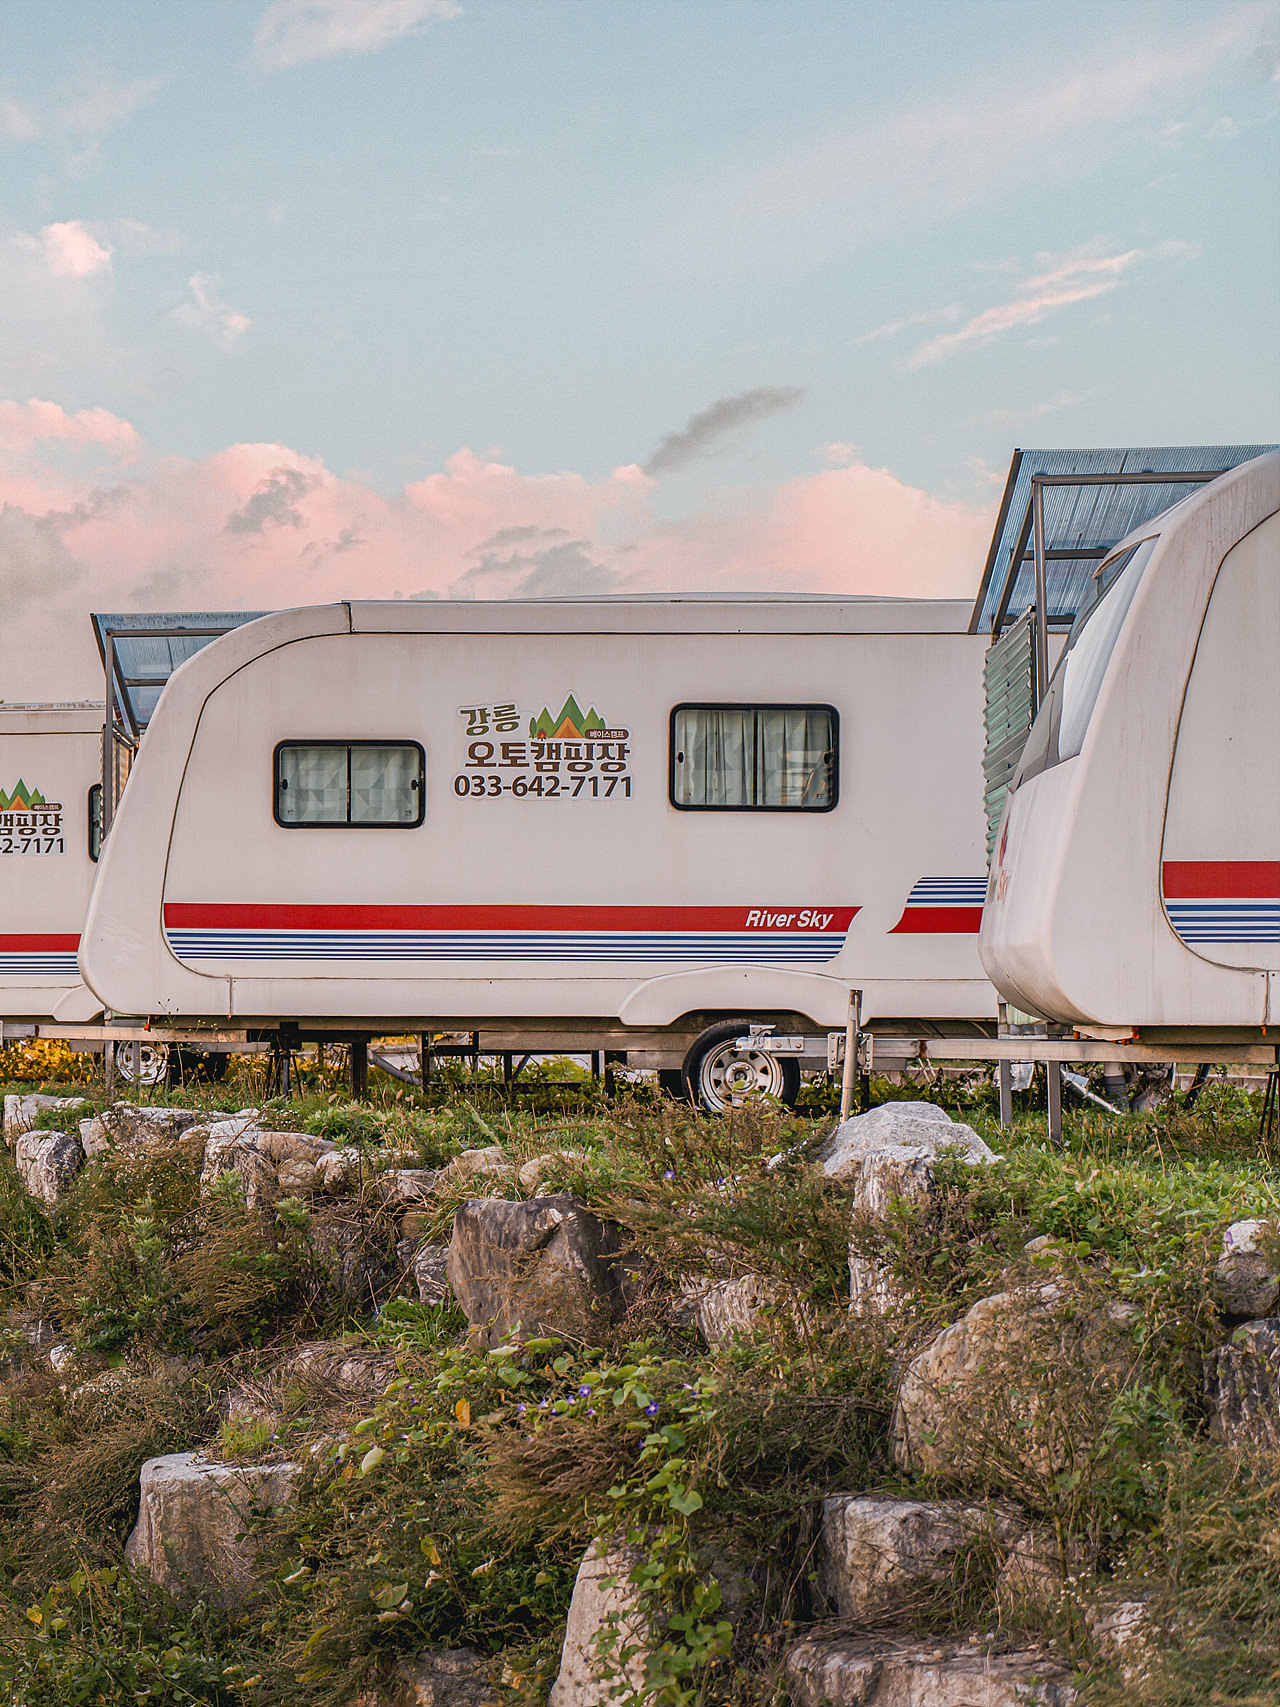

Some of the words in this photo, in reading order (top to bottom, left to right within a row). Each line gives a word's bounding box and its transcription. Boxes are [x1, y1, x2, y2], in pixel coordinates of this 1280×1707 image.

[460, 704, 520, 736] 강릉
[589, 730, 625, 739] 베이스캠프
[465, 741, 630, 773] 오토캠핑장
[454, 775, 631, 798] 033-642-7171
[745, 910, 796, 927] River
[797, 910, 834, 930] Sky
